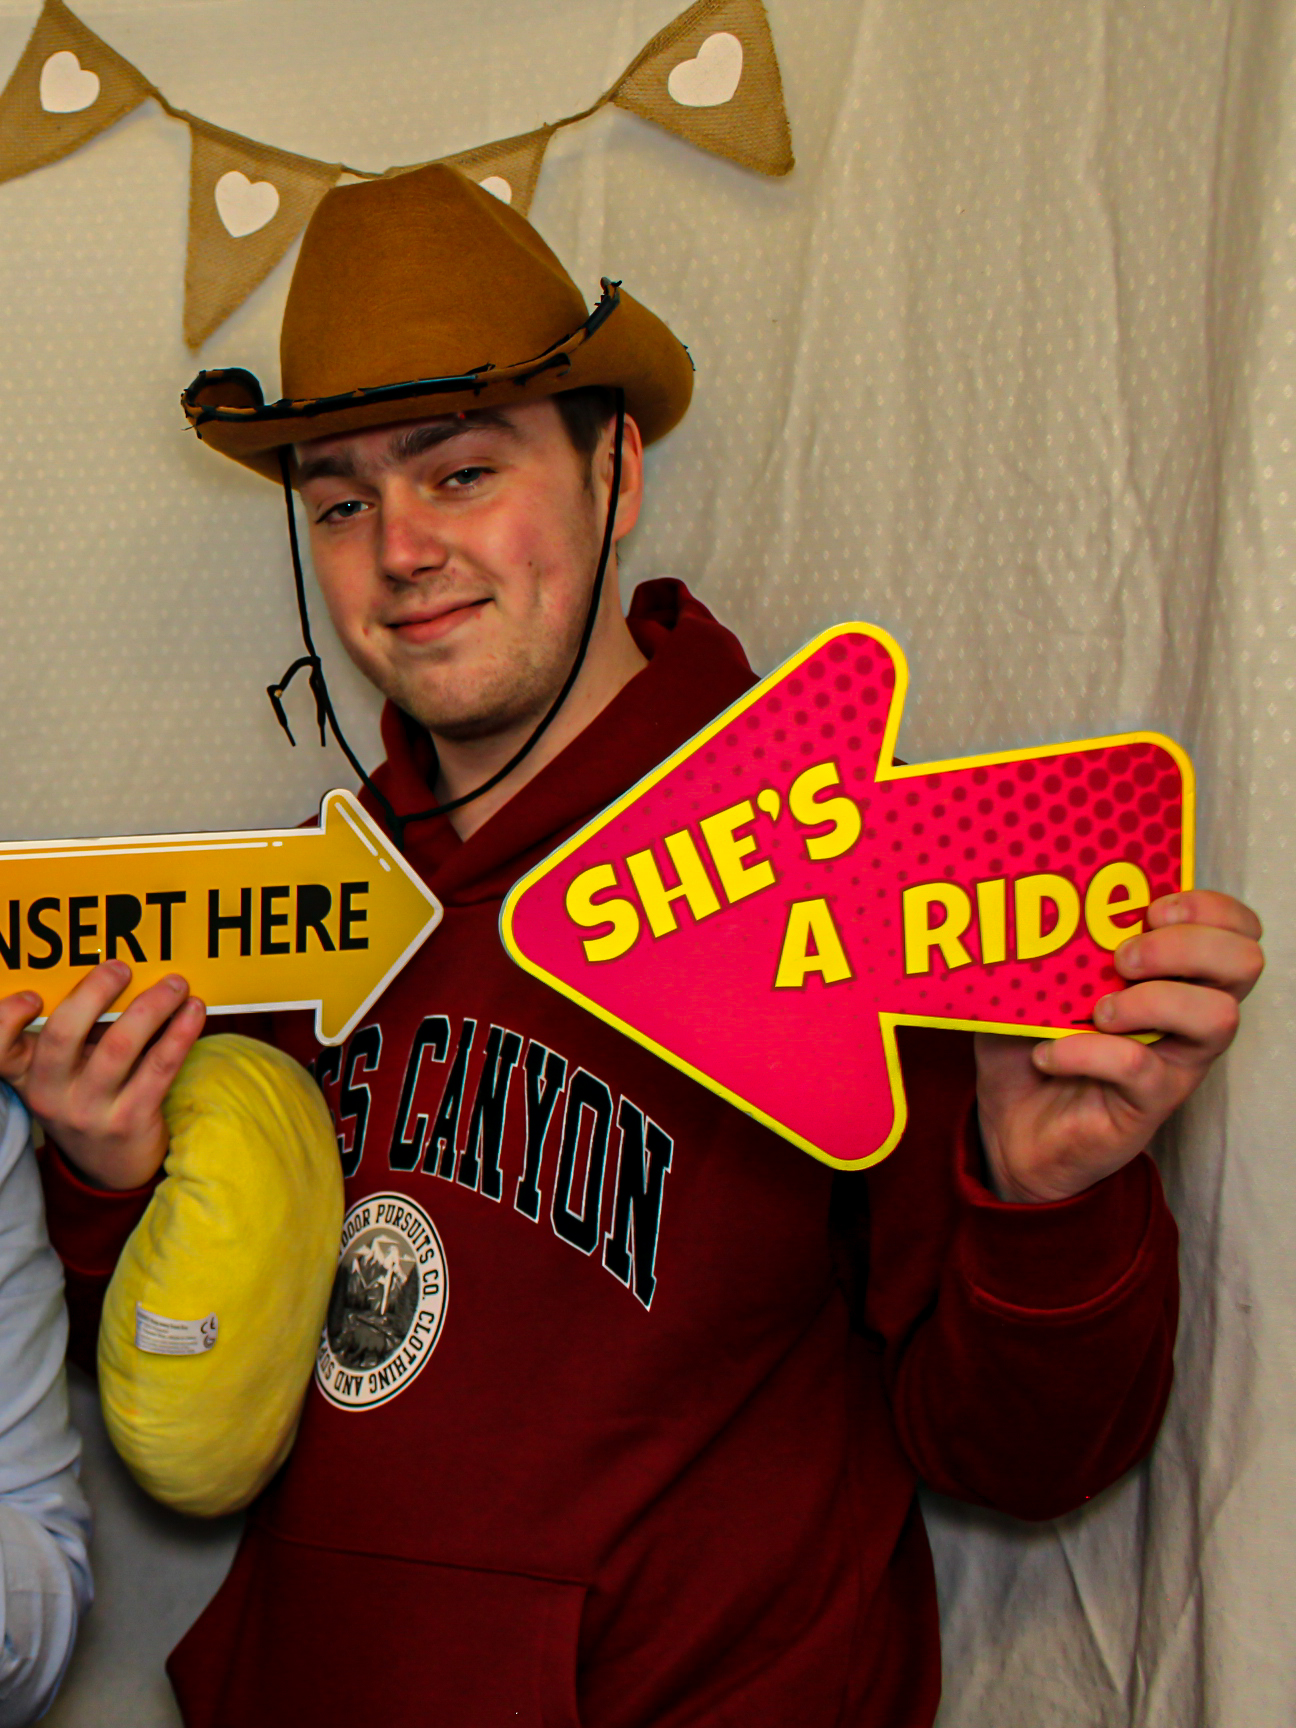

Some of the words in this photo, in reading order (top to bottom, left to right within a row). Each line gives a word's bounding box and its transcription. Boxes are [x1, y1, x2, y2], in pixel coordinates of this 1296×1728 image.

[207, 881, 370, 959] HERE
[774, 898, 853, 988] A
[388, 1014, 675, 1313] CANYON
[375, 1203, 435, 1265] PURSUITS
[422, 1269, 440, 1300] CO.
[334, 1370, 365, 1397] AND
[369, 1310, 436, 1393] CLOTHING
